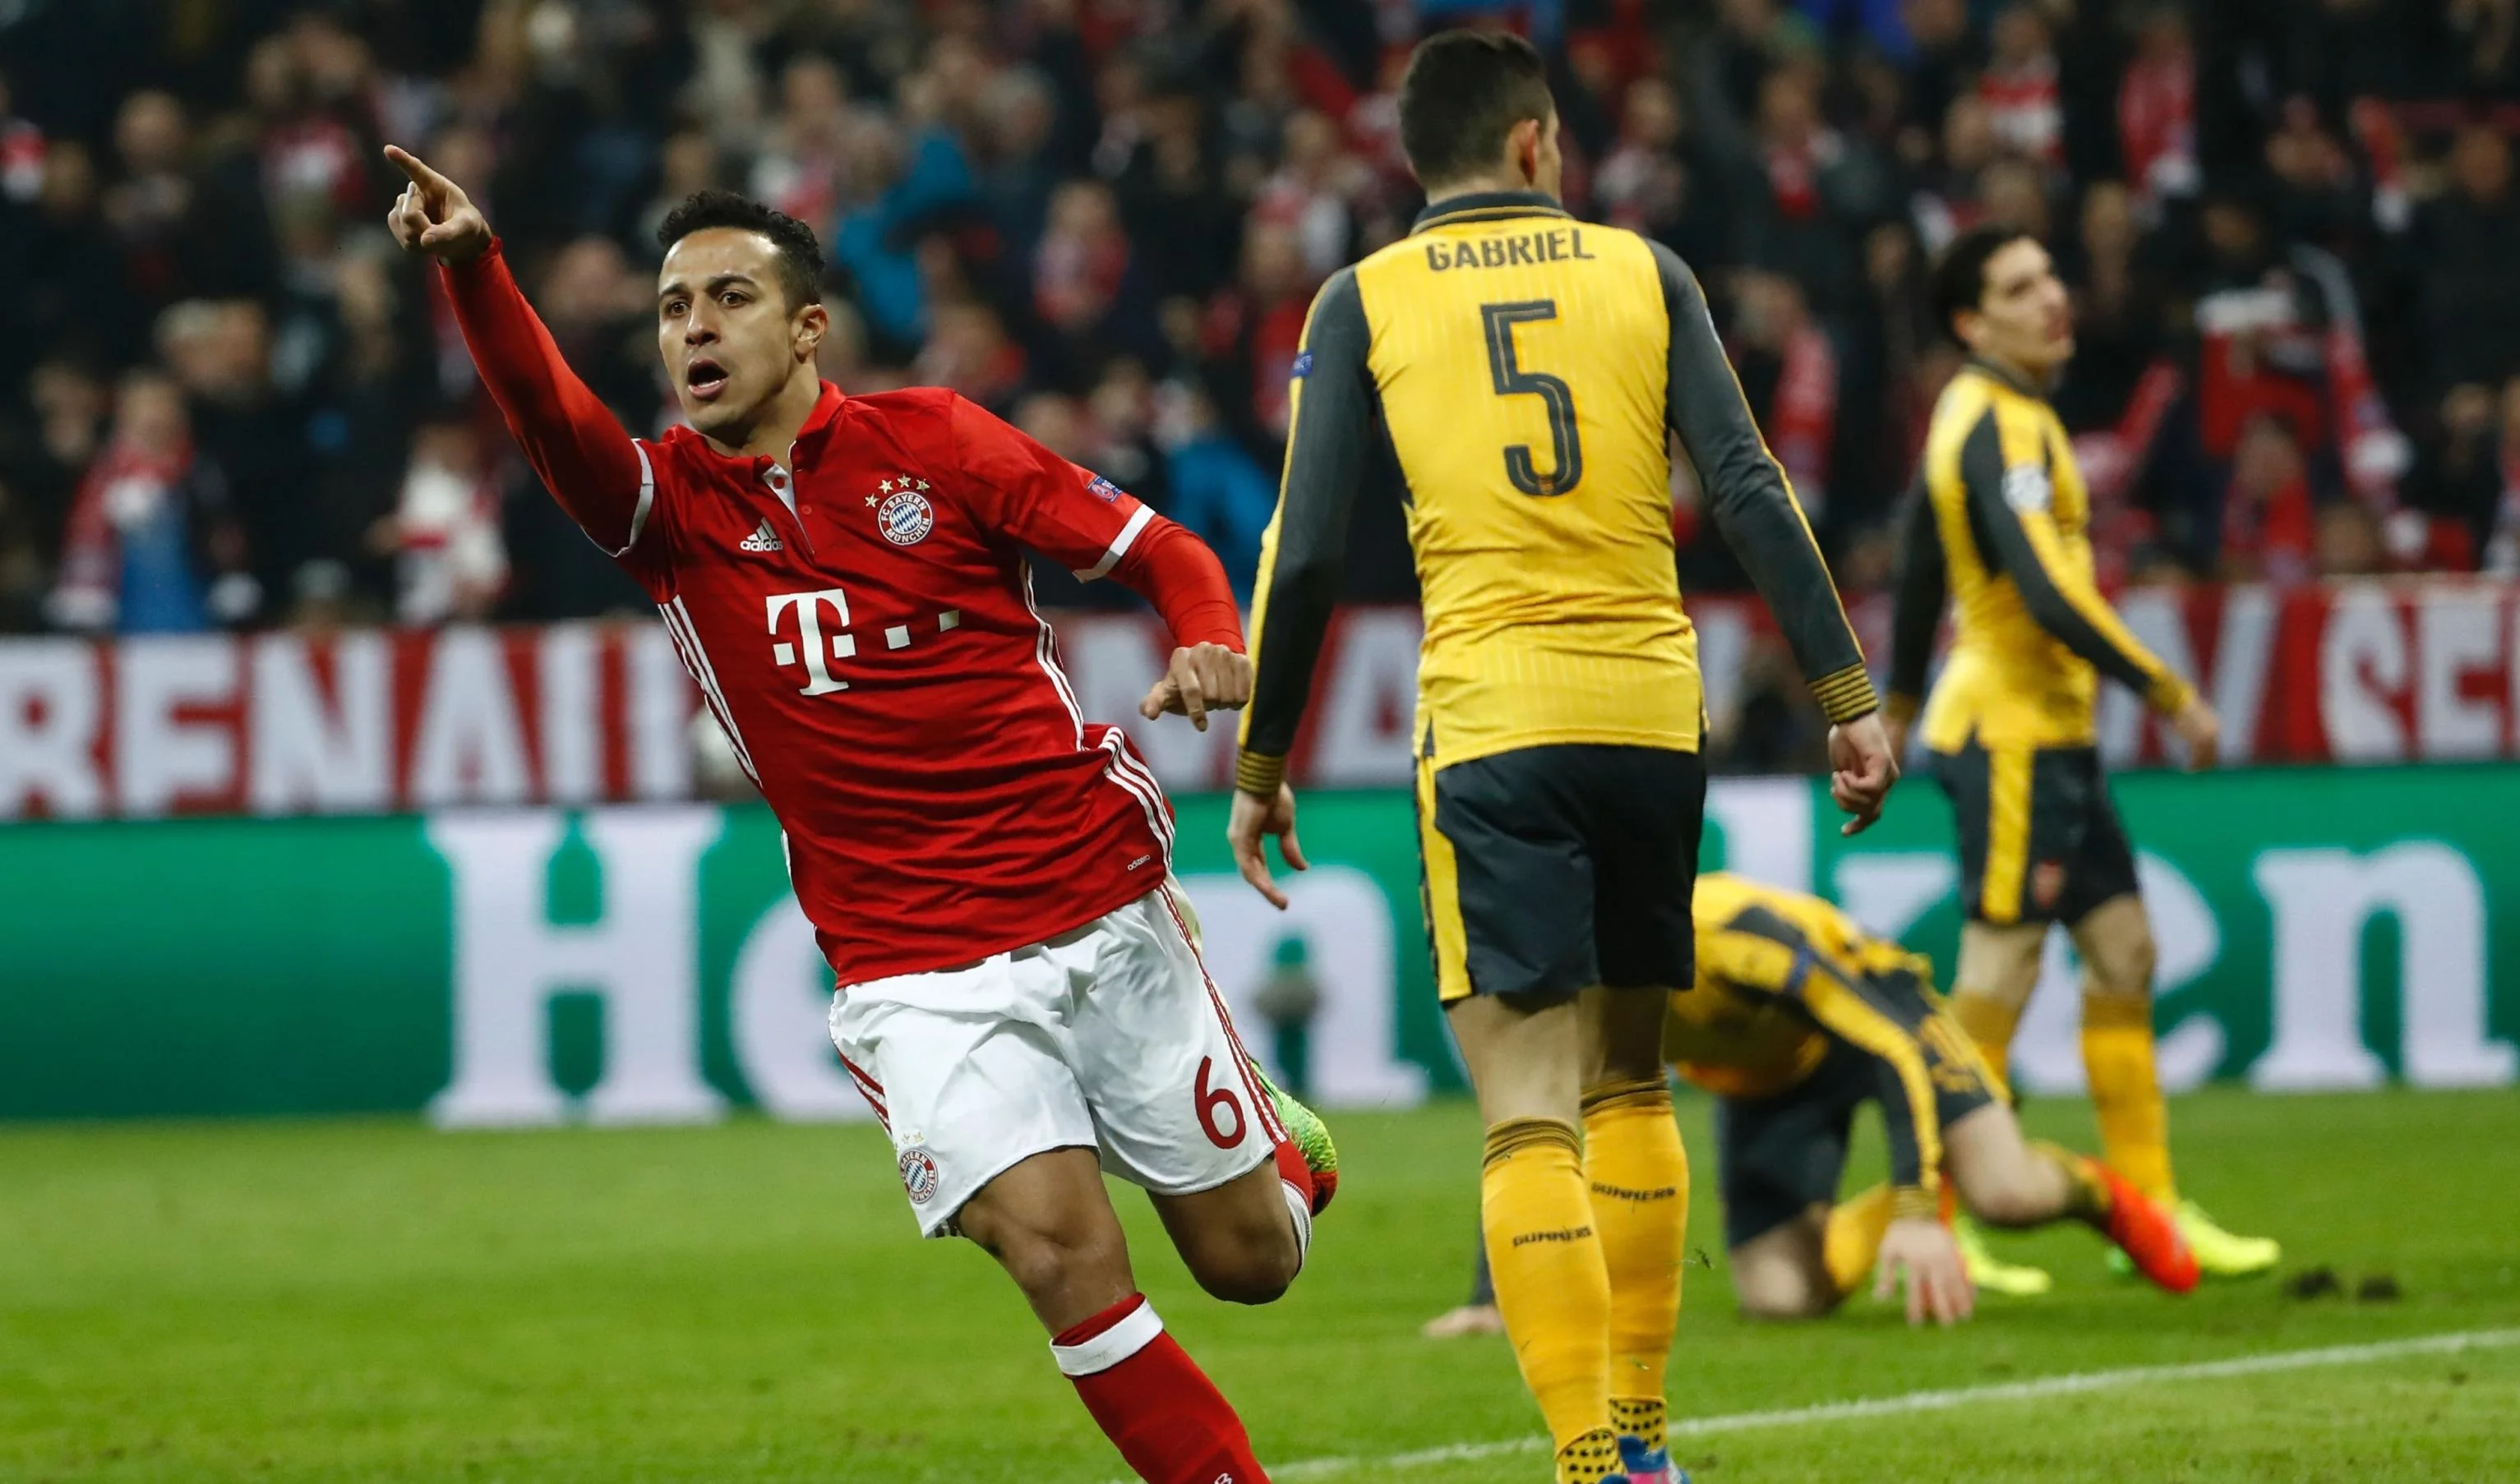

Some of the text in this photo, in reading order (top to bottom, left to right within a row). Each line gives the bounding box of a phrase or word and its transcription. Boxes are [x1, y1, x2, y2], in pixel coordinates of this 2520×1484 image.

[1426, 228, 1595, 272] GABRIEL
[1480, 299, 1582, 496] 5
[881, 495, 926, 521] FC BAYERN
[740, 539, 782, 551] adidas
[1194, 1055, 1246, 1150] 6
